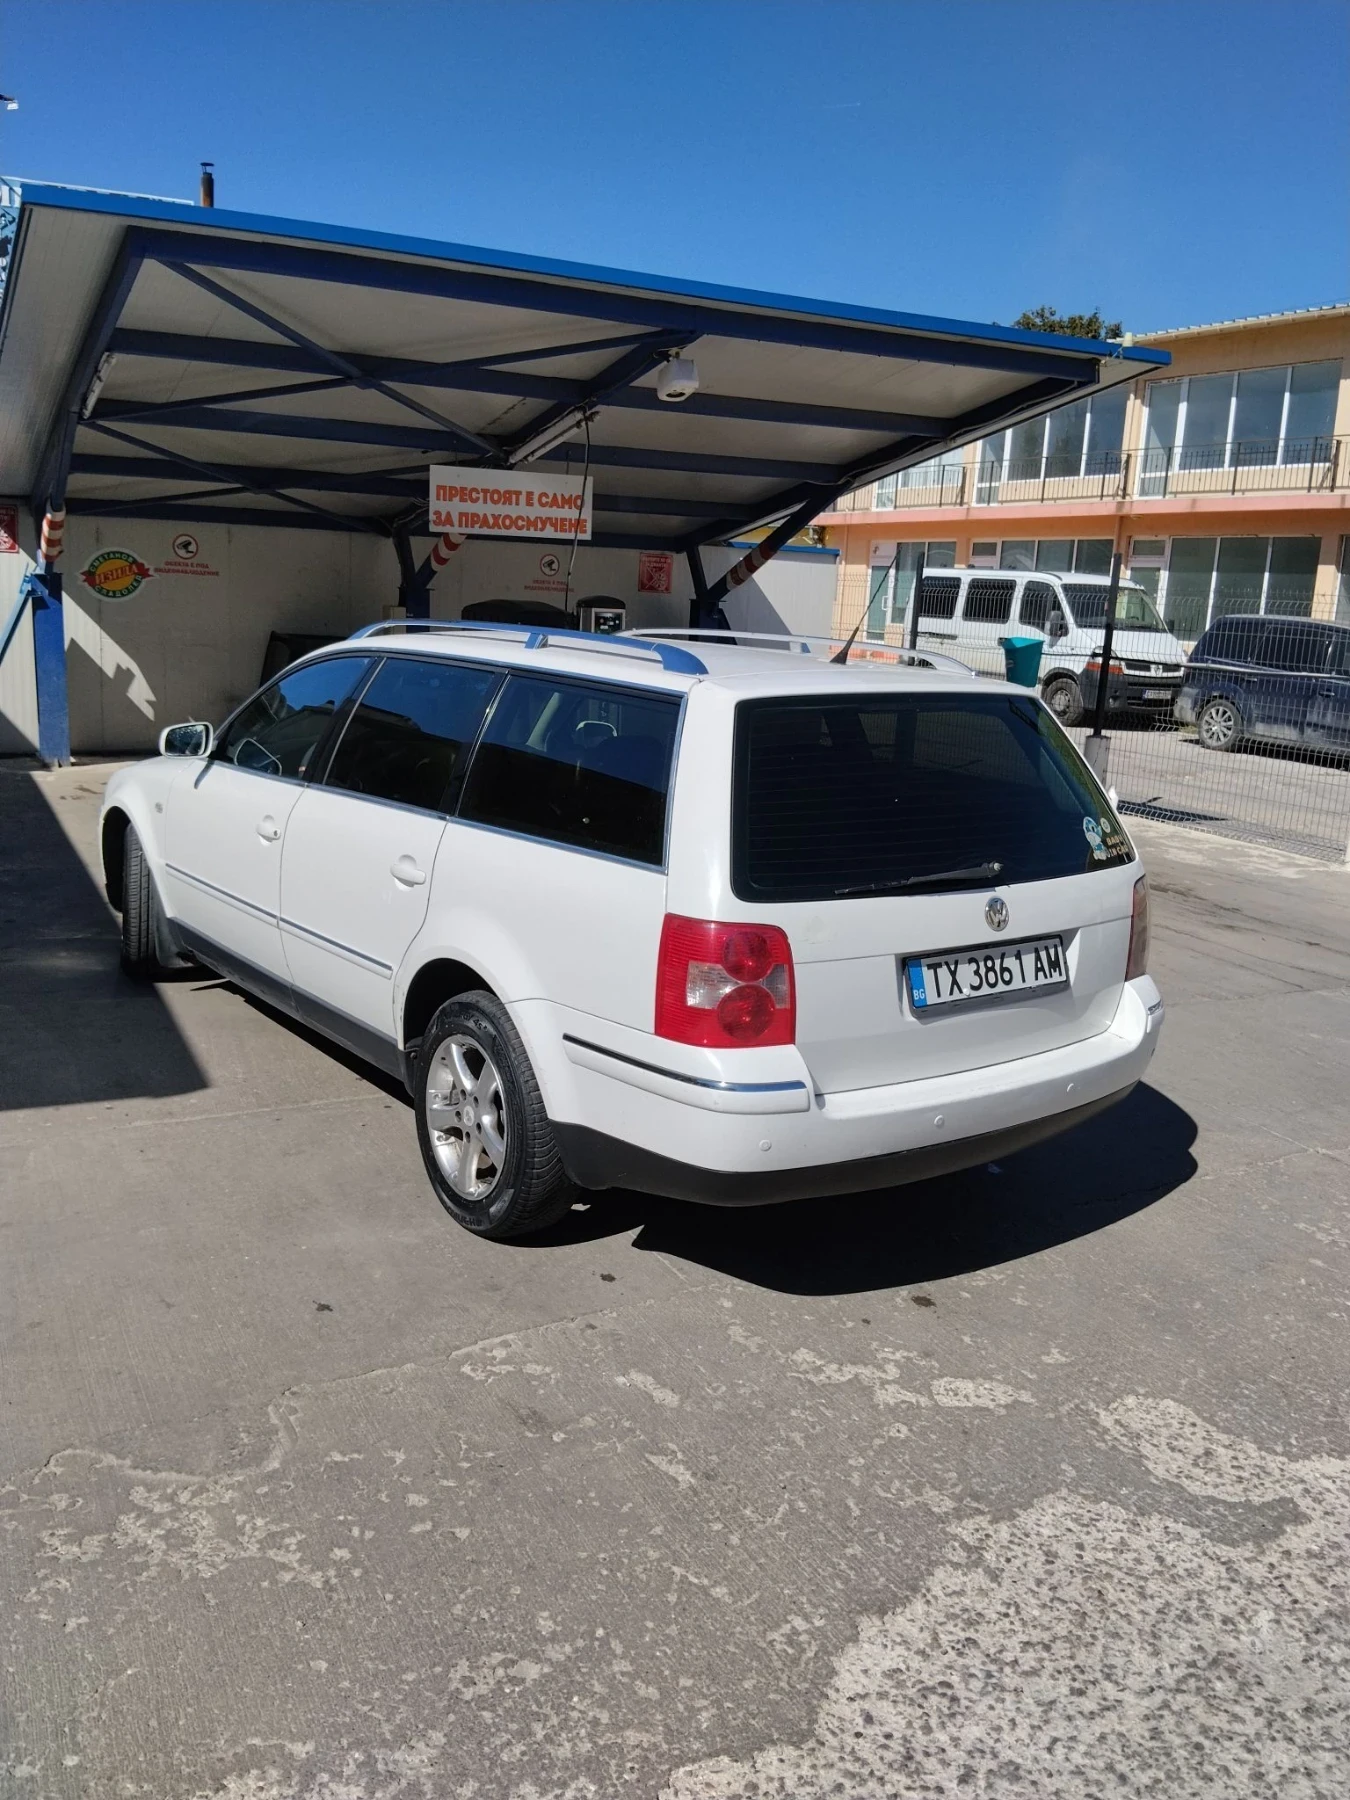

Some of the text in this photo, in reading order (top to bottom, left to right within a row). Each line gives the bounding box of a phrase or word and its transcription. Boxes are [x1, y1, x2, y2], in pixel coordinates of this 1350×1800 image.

[435, 484, 585, 510] ПРЕСТОЯТ Е САМО
[432, 510, 588, 534] ЗА ПРАХОСМУЧЕНЕ
[926, 944, 1062, 998] TX 3861 AM
[913, 988, 925, 1000] BG
